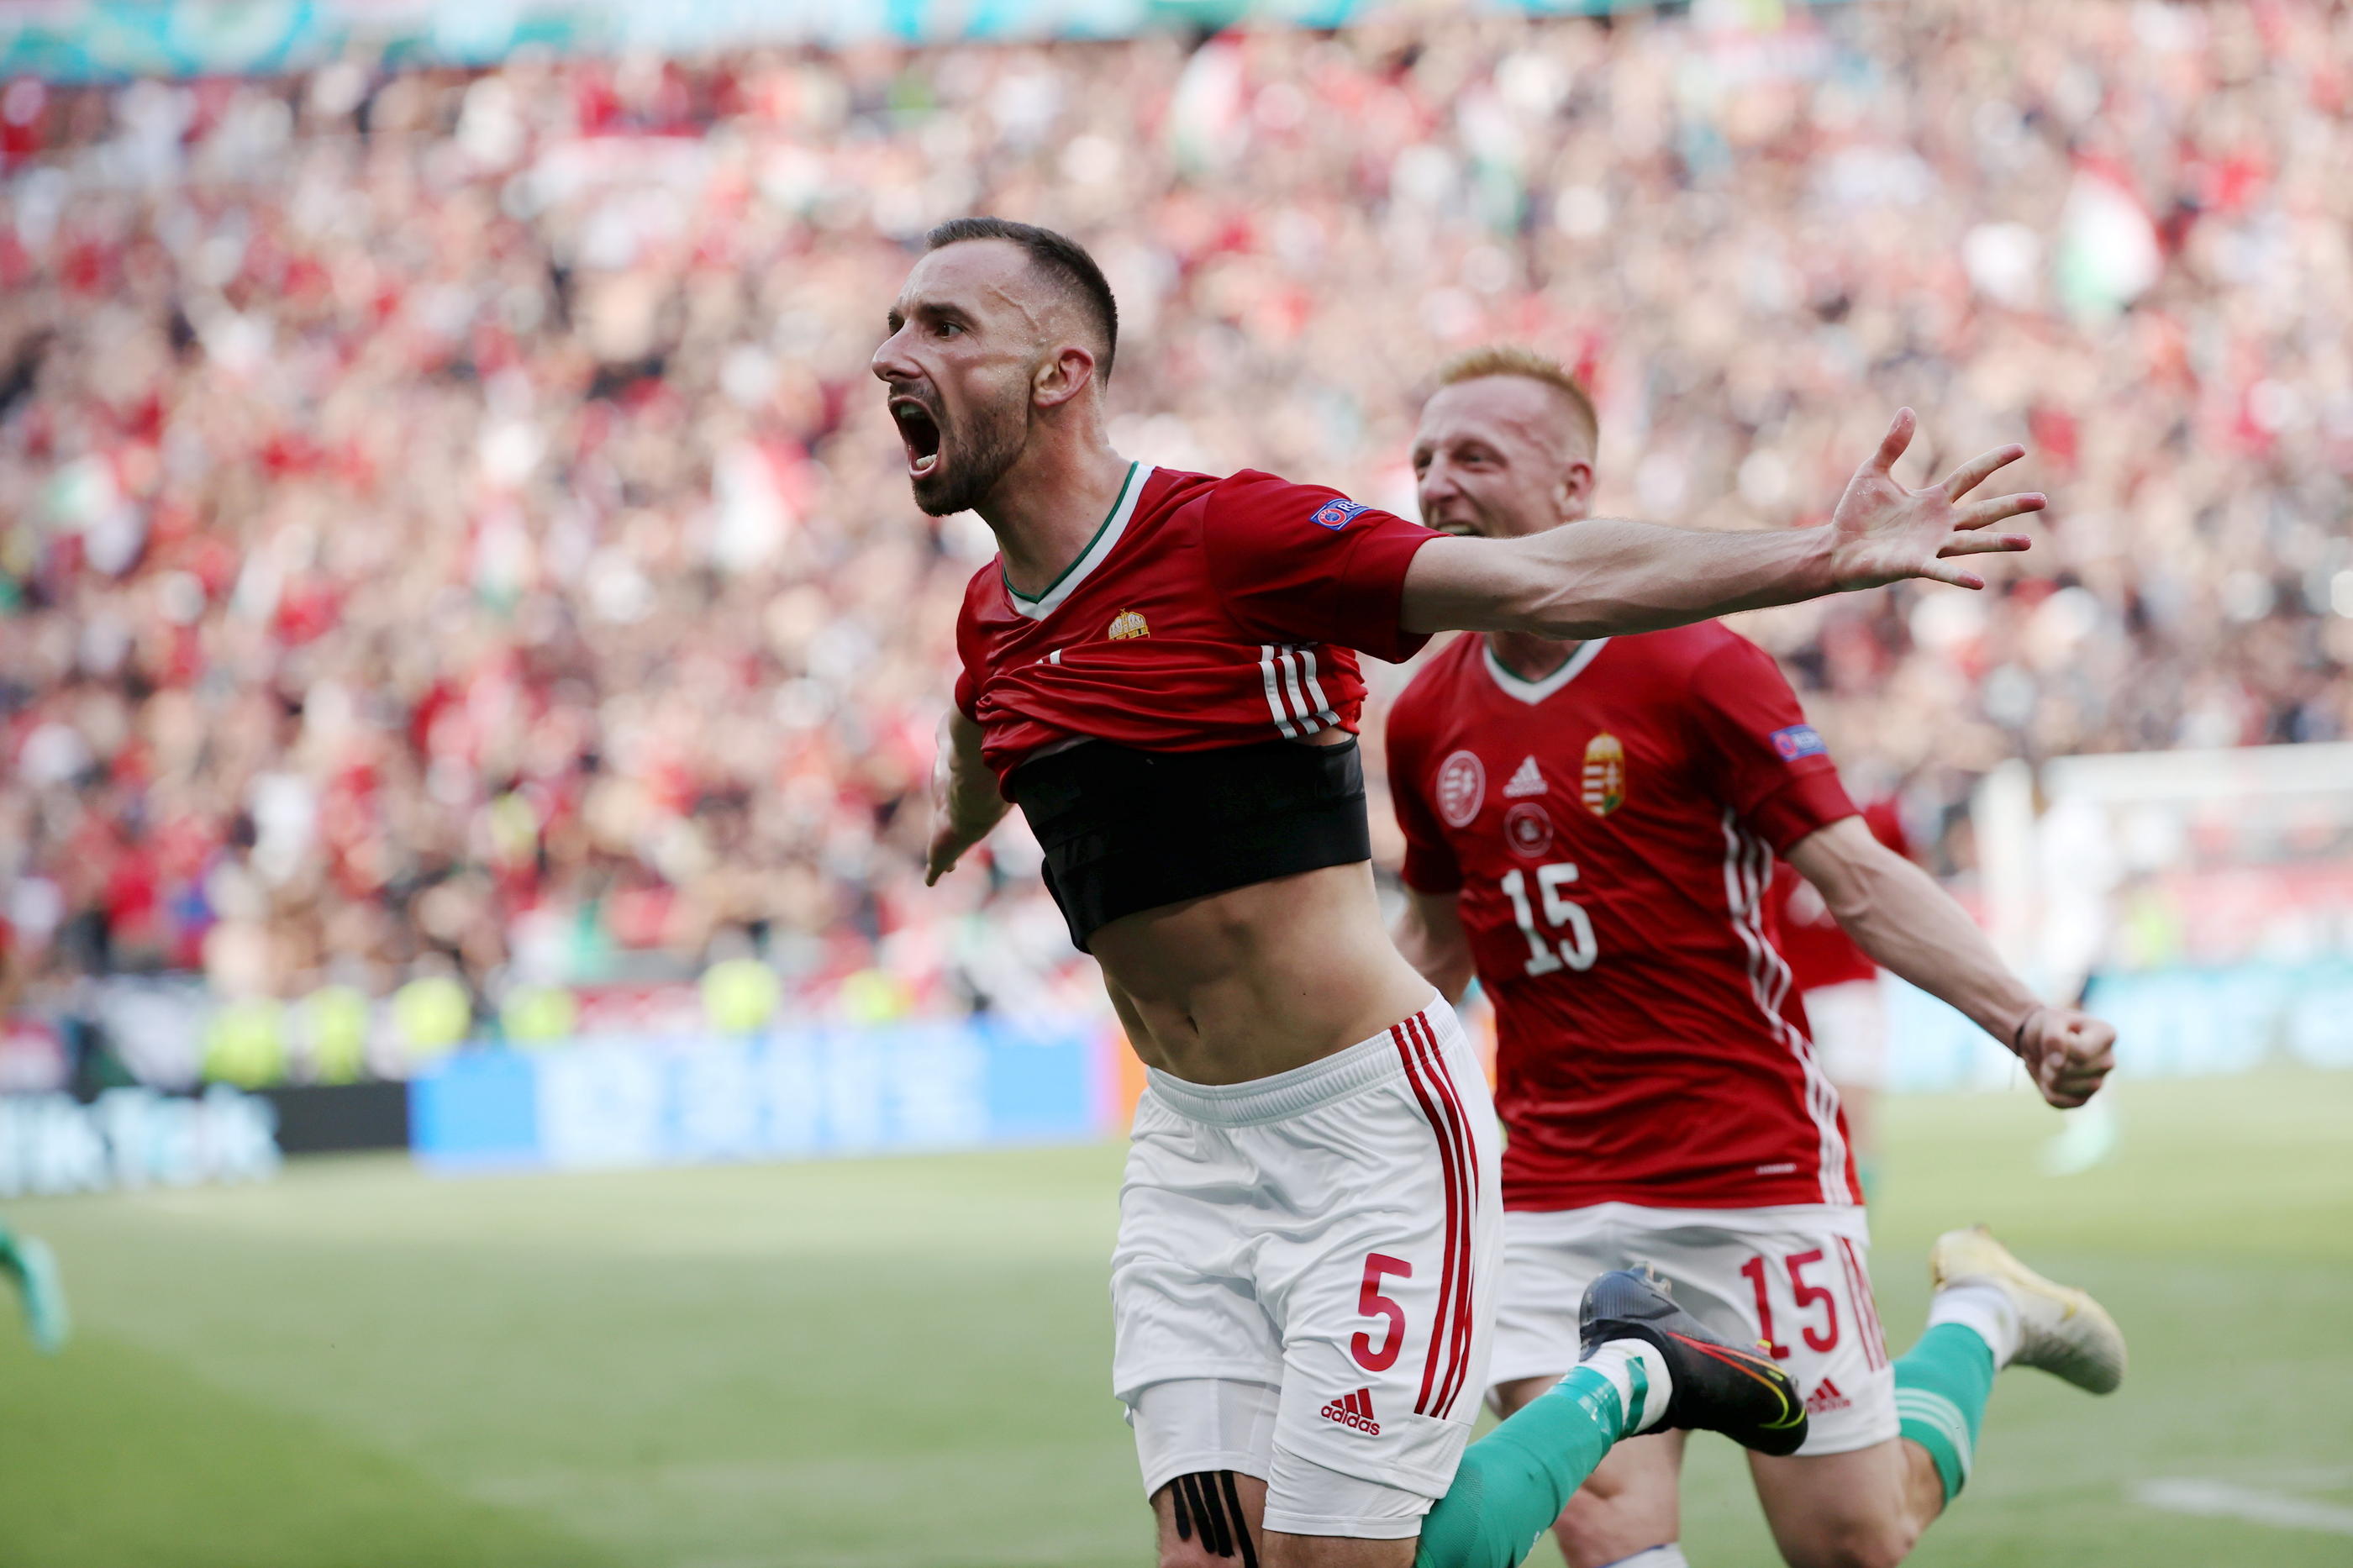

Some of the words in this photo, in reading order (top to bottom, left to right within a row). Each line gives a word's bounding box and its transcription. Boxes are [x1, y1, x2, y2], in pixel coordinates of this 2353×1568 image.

[1501, 862, 1598, 976] 15
[1350, 1252, 1413, 1371] 5
[1740, 1249, 1839, 1360] 15
[1321, 1406, 1380, 1435] adidas
